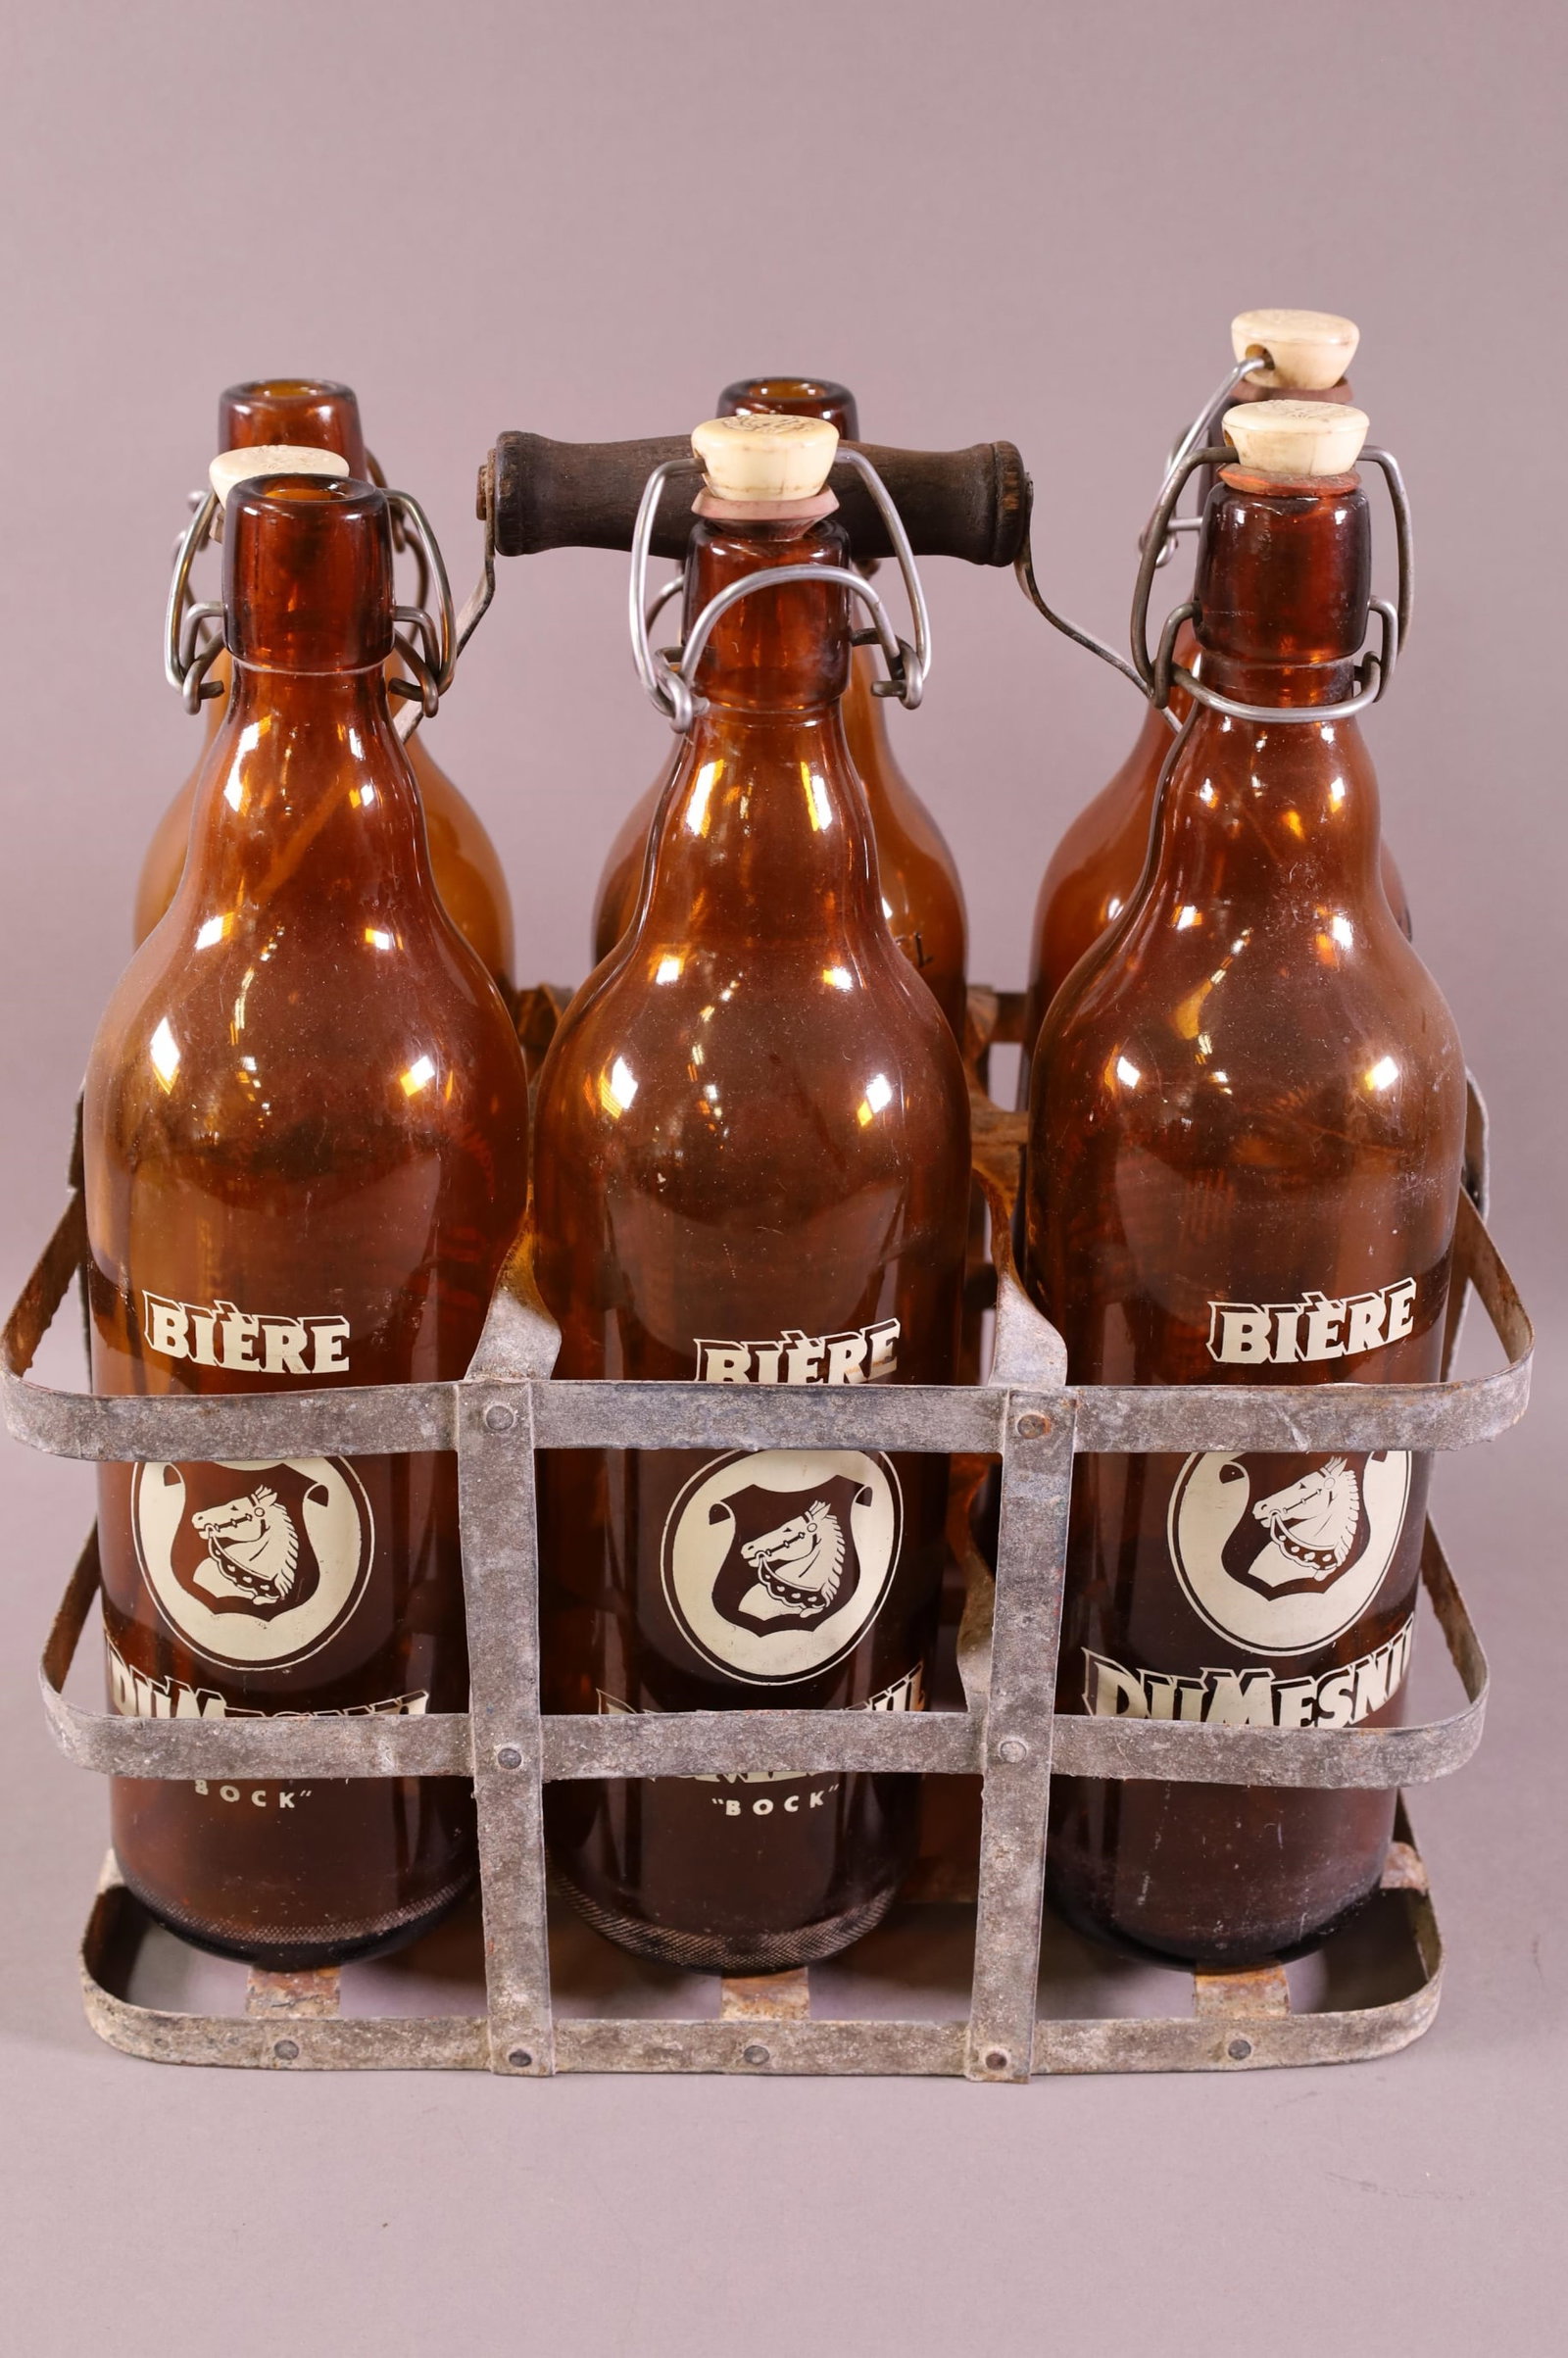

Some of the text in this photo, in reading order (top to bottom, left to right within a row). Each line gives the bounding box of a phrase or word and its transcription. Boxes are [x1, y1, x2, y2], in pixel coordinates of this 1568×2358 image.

[142, 1290, 350, 1374] BIÈRE
[693, 1317, 901, 1385] BIÈRE
[1205, 1277, 1417, 1364] BIÈRE
